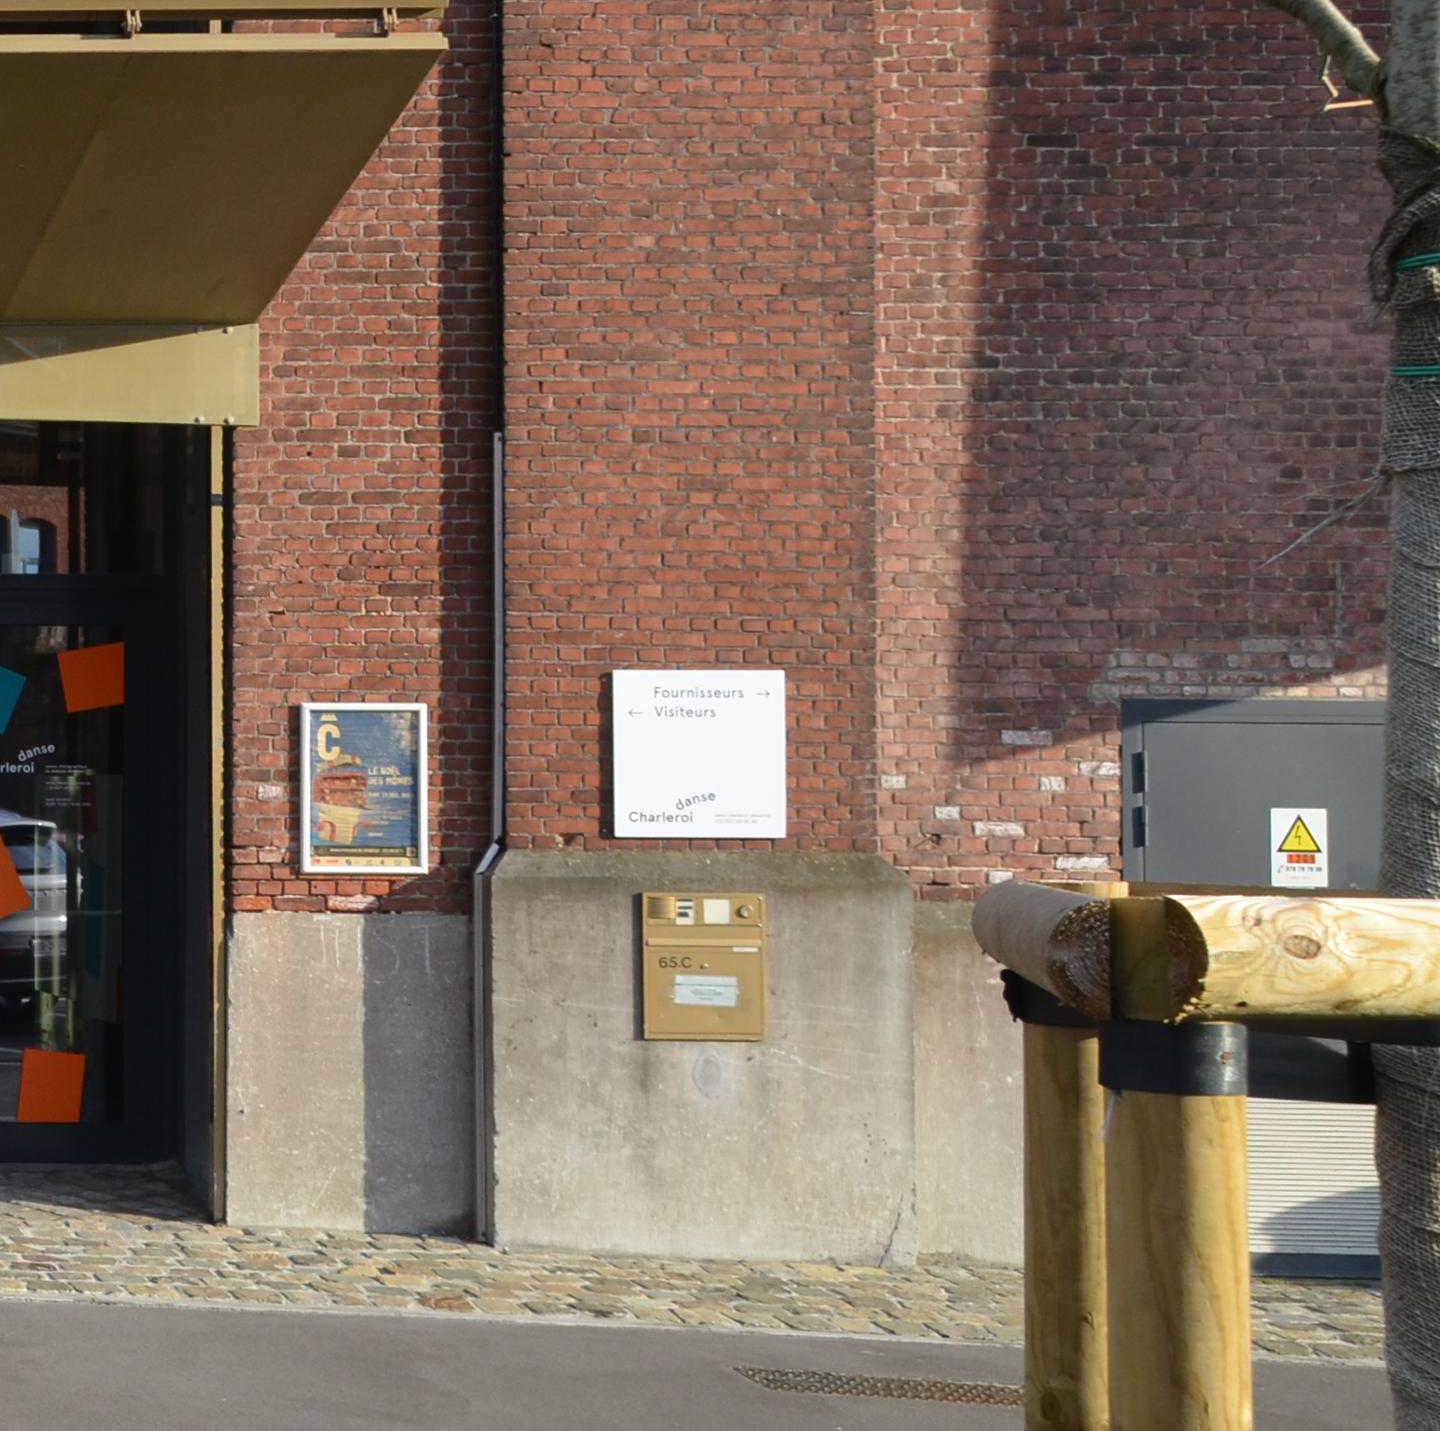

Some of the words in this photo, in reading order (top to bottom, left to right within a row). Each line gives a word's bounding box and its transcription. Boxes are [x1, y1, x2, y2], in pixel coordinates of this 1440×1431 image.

[653, 686, 745, 699] Fournisseurs
[654, 706, 717, 718] Visiteurs
[18, 744, 56, 762] danse
[675, 792, 716, 811] danse
[628, 811, 694, 824] Charleroi
